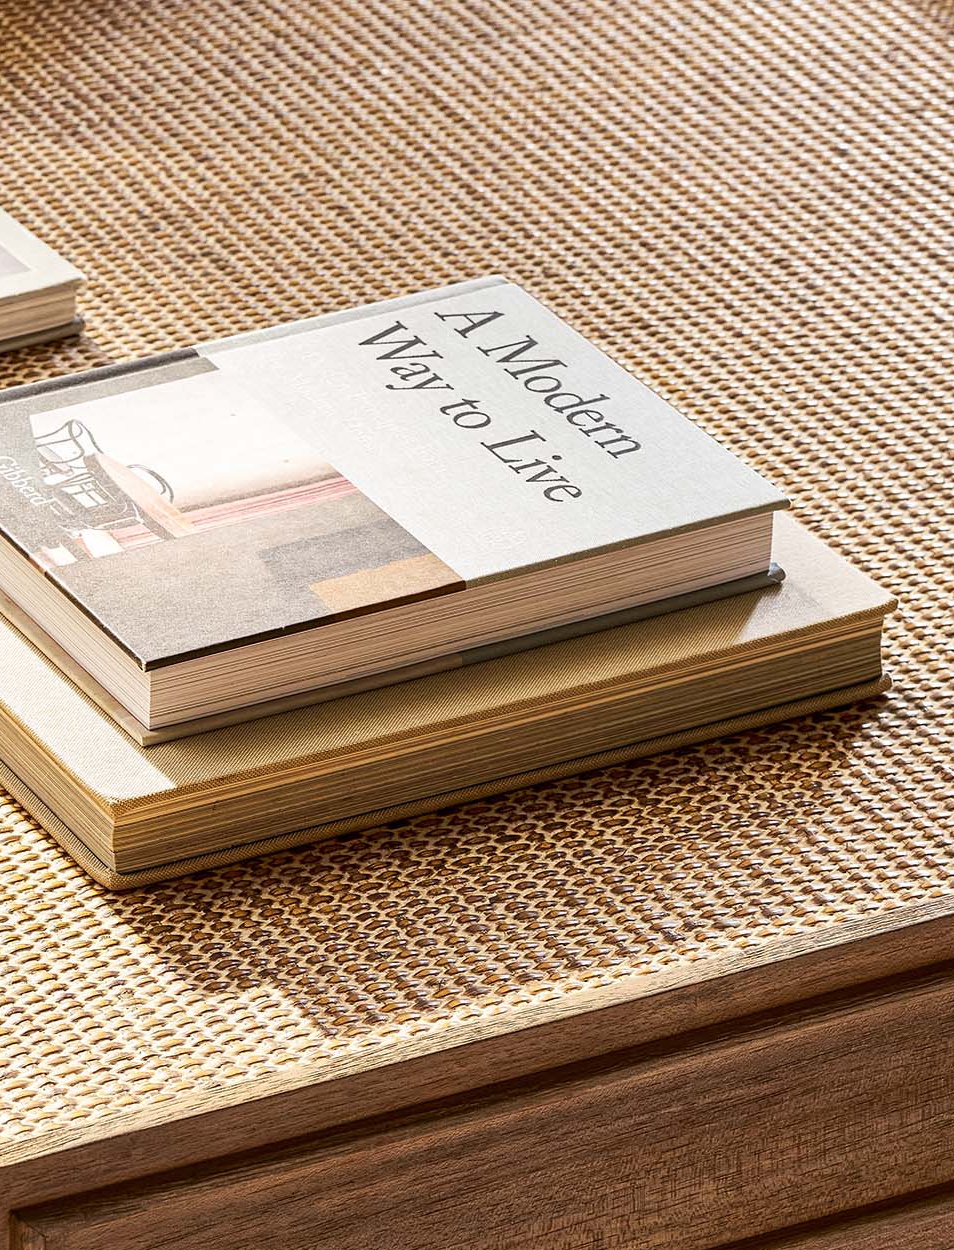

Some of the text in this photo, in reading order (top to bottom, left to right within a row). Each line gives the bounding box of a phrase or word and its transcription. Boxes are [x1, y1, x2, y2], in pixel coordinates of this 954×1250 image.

[358, 320, 455, 391] Way
[440, 397, 492, 430] to
[481, 429, 583, 502] Live
[433, 310, 505, 339] A
[477, 335, 642, 459] Modern
